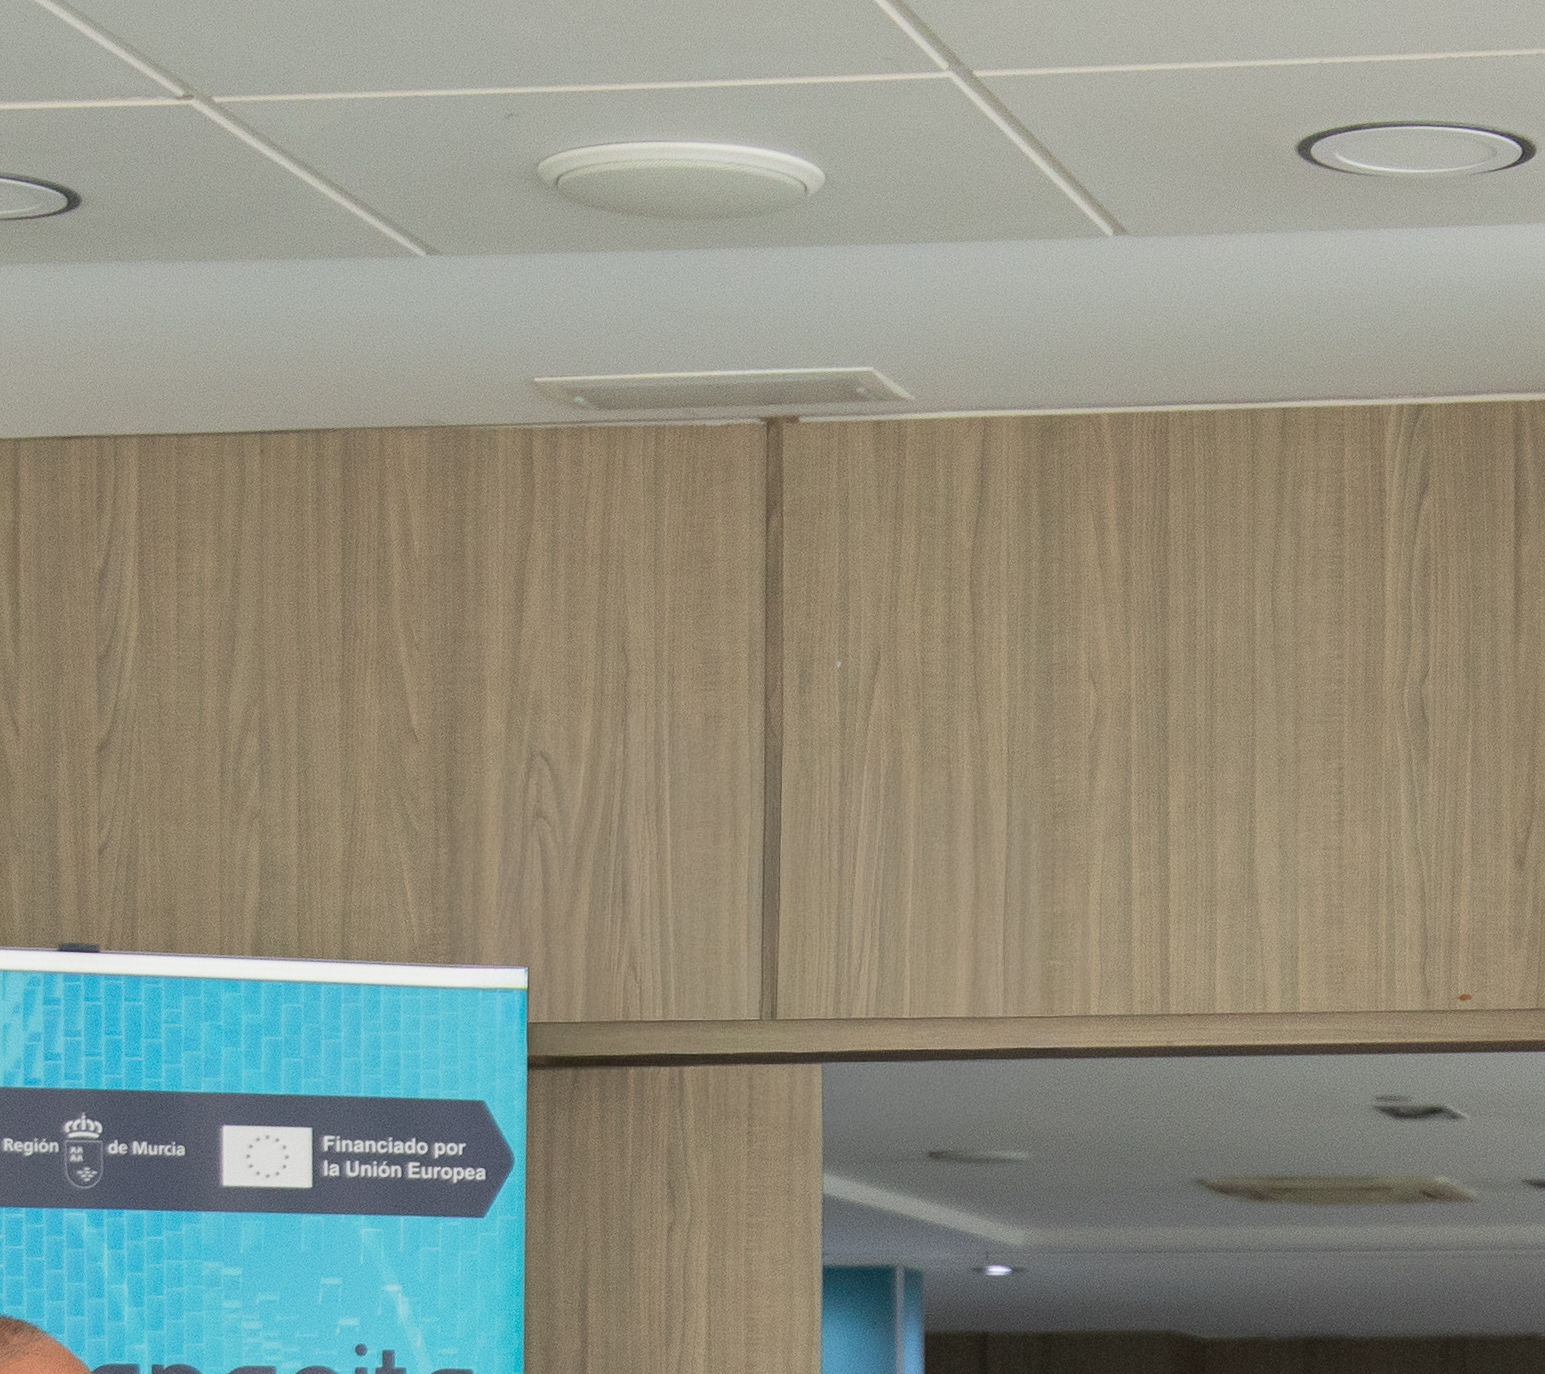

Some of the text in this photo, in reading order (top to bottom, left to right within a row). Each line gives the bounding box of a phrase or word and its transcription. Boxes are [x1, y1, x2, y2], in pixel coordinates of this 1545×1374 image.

[2, 1136, 186, 1158] Región de Murcia
[322, 1134, 467, 1159] Financiado por
[322, 1159, 487, 1182] la Unión Europea
